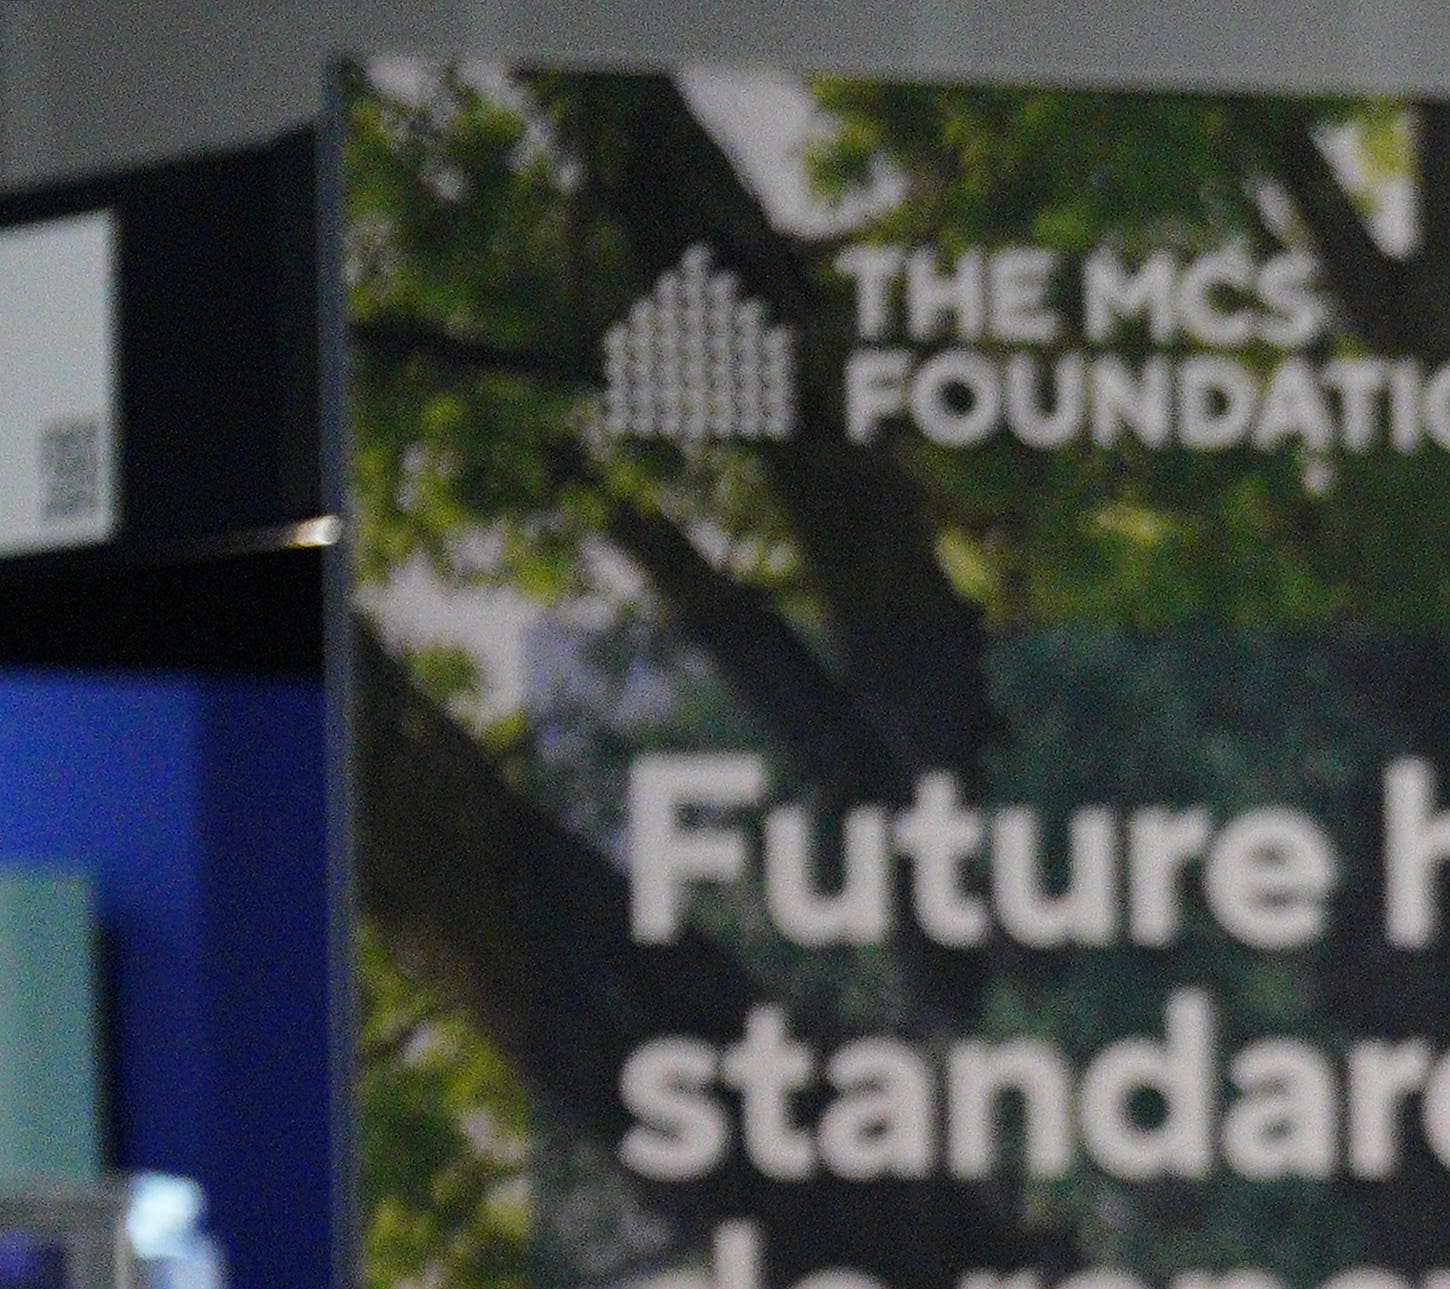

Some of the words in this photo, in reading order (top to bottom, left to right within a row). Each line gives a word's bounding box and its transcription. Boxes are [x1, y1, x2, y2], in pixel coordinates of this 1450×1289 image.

[833, 243, 1059, 345] THE
[1080, 250, 1329, 348] MCS
[626, 749, 1340, 949] Future
